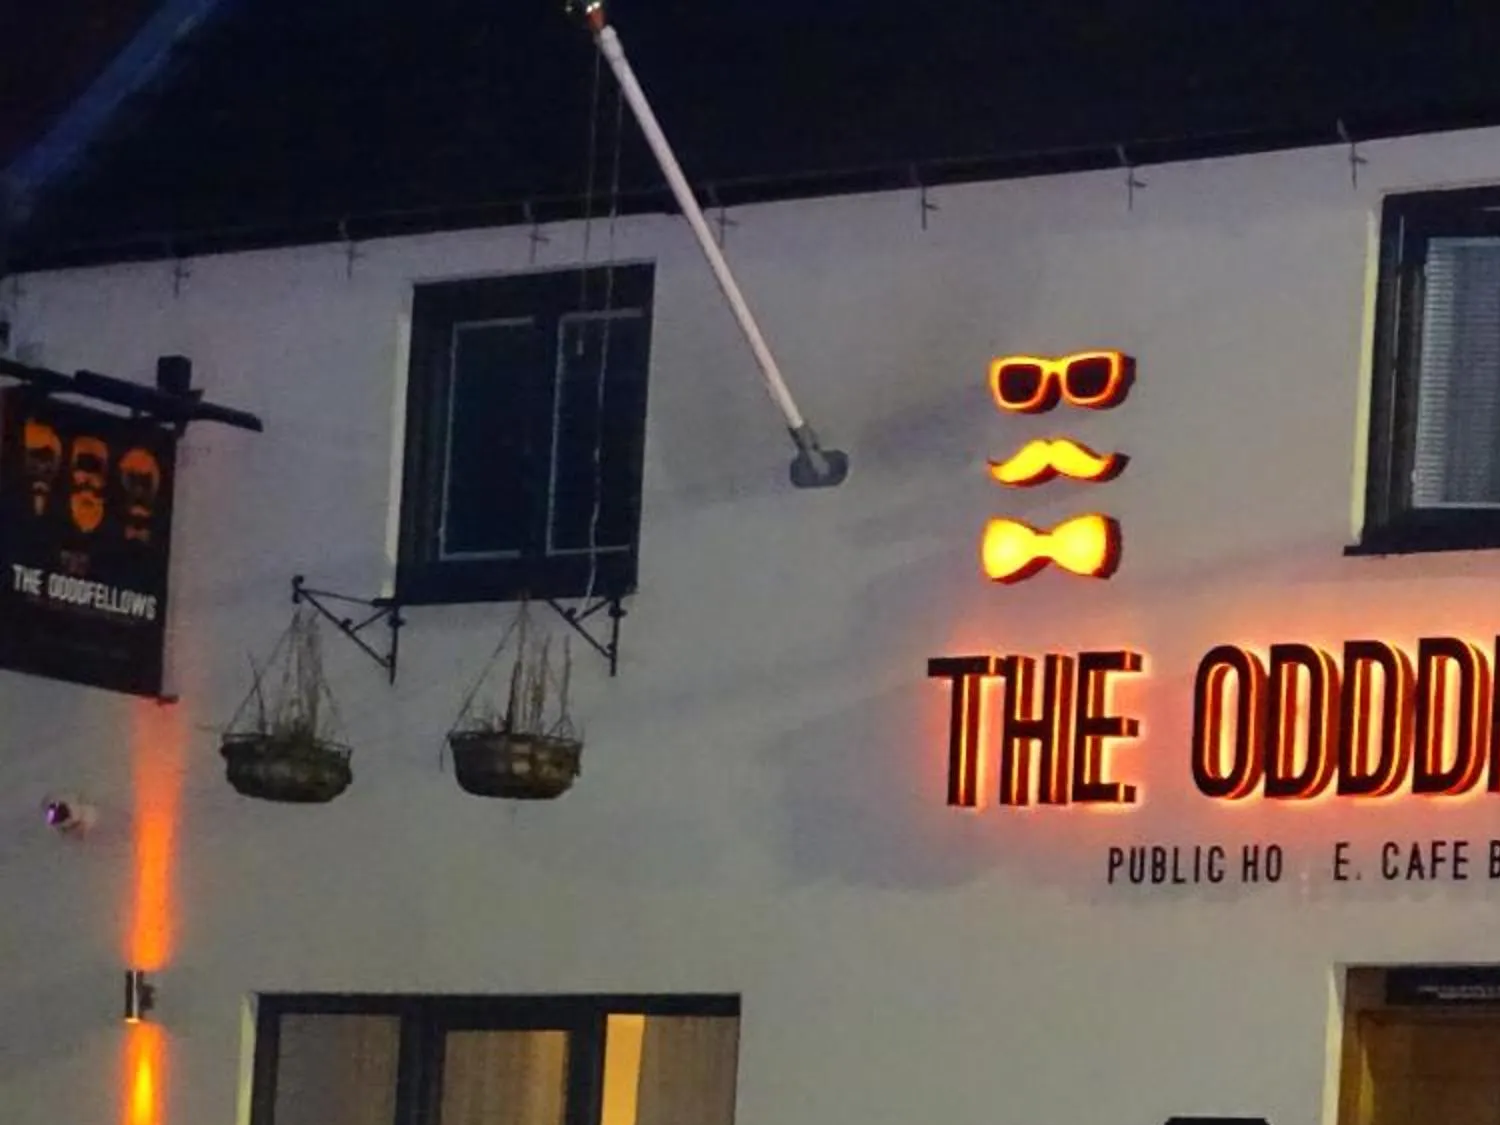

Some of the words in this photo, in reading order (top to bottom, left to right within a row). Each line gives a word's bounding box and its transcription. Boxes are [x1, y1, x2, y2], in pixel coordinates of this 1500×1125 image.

[12, 563, 43, 596] THE
[928, 651, 1143, 807] THE
[1108, 846, 1226, 884] PUBLIC
[1382, 841, 1469, 880] CAFE
